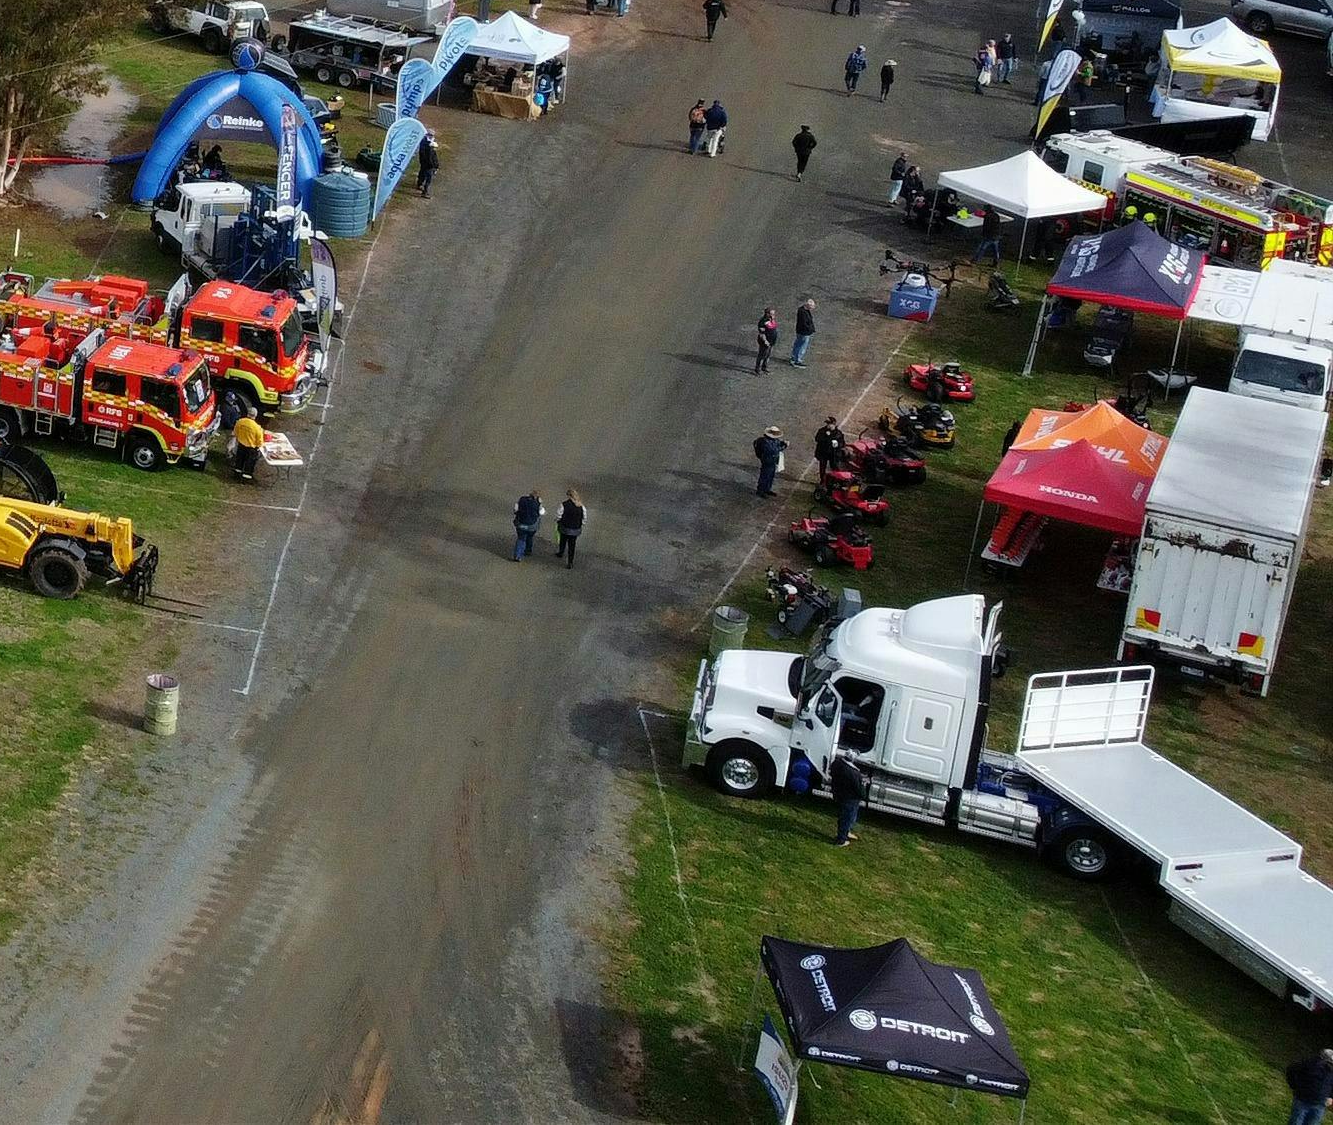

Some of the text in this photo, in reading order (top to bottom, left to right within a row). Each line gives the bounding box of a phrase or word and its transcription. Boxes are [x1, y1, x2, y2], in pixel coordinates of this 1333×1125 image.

[438, 36, 469, 72] pivots
[401, 77, 424, 118] pumps
[223, 115, 265, 129] Reinke
[277, 144, 297, 202] FENCER
[1038, 484, 1100, 504] HONDA
[811, 969, 837, 1013] DETROIT
[880, 1016, 971, 1045] DETROIT
[821, 1049, 862, 1063] DETROIT
[899, 1062, 940, 1076] DETROIT
[979, 1077, 1020, 1091] DETROIT
